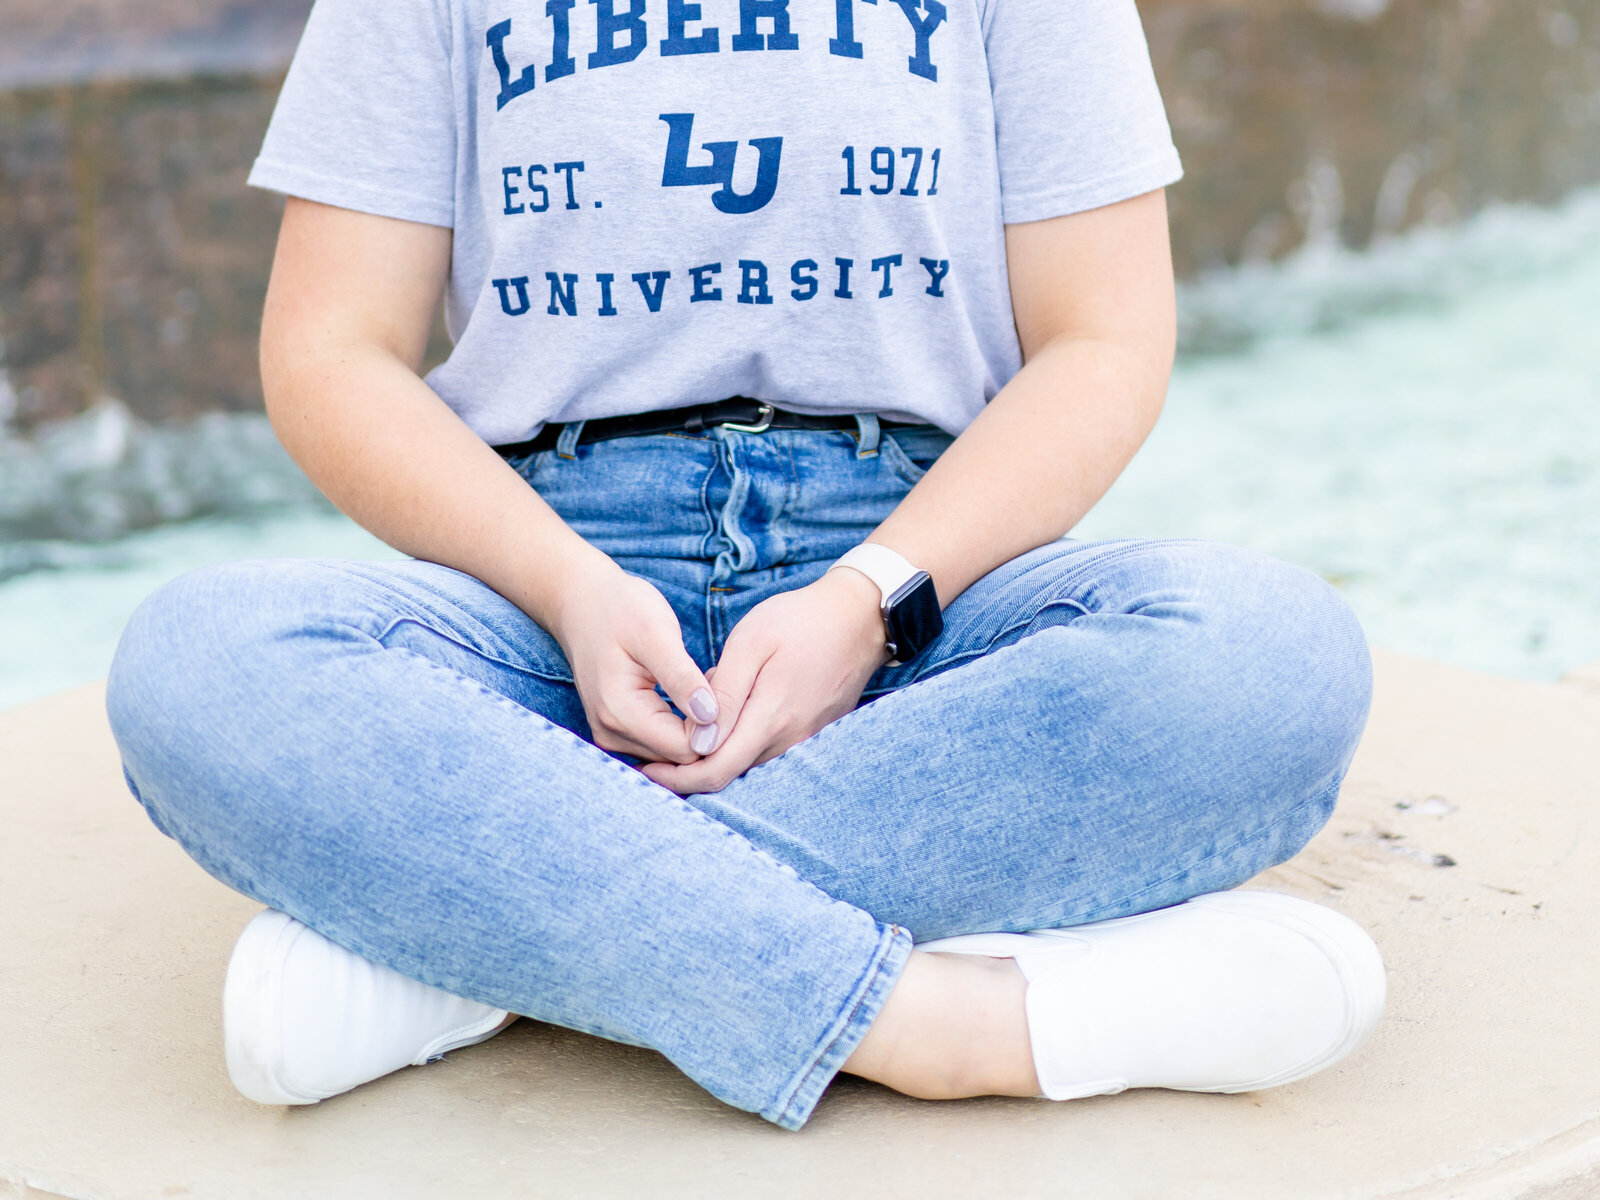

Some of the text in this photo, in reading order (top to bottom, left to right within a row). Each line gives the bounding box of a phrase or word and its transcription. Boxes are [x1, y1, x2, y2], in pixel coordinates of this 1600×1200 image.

[502, 113, 941, 215] EST. LU 1971
[492, 253, 950, 316] UNIVERSITY
